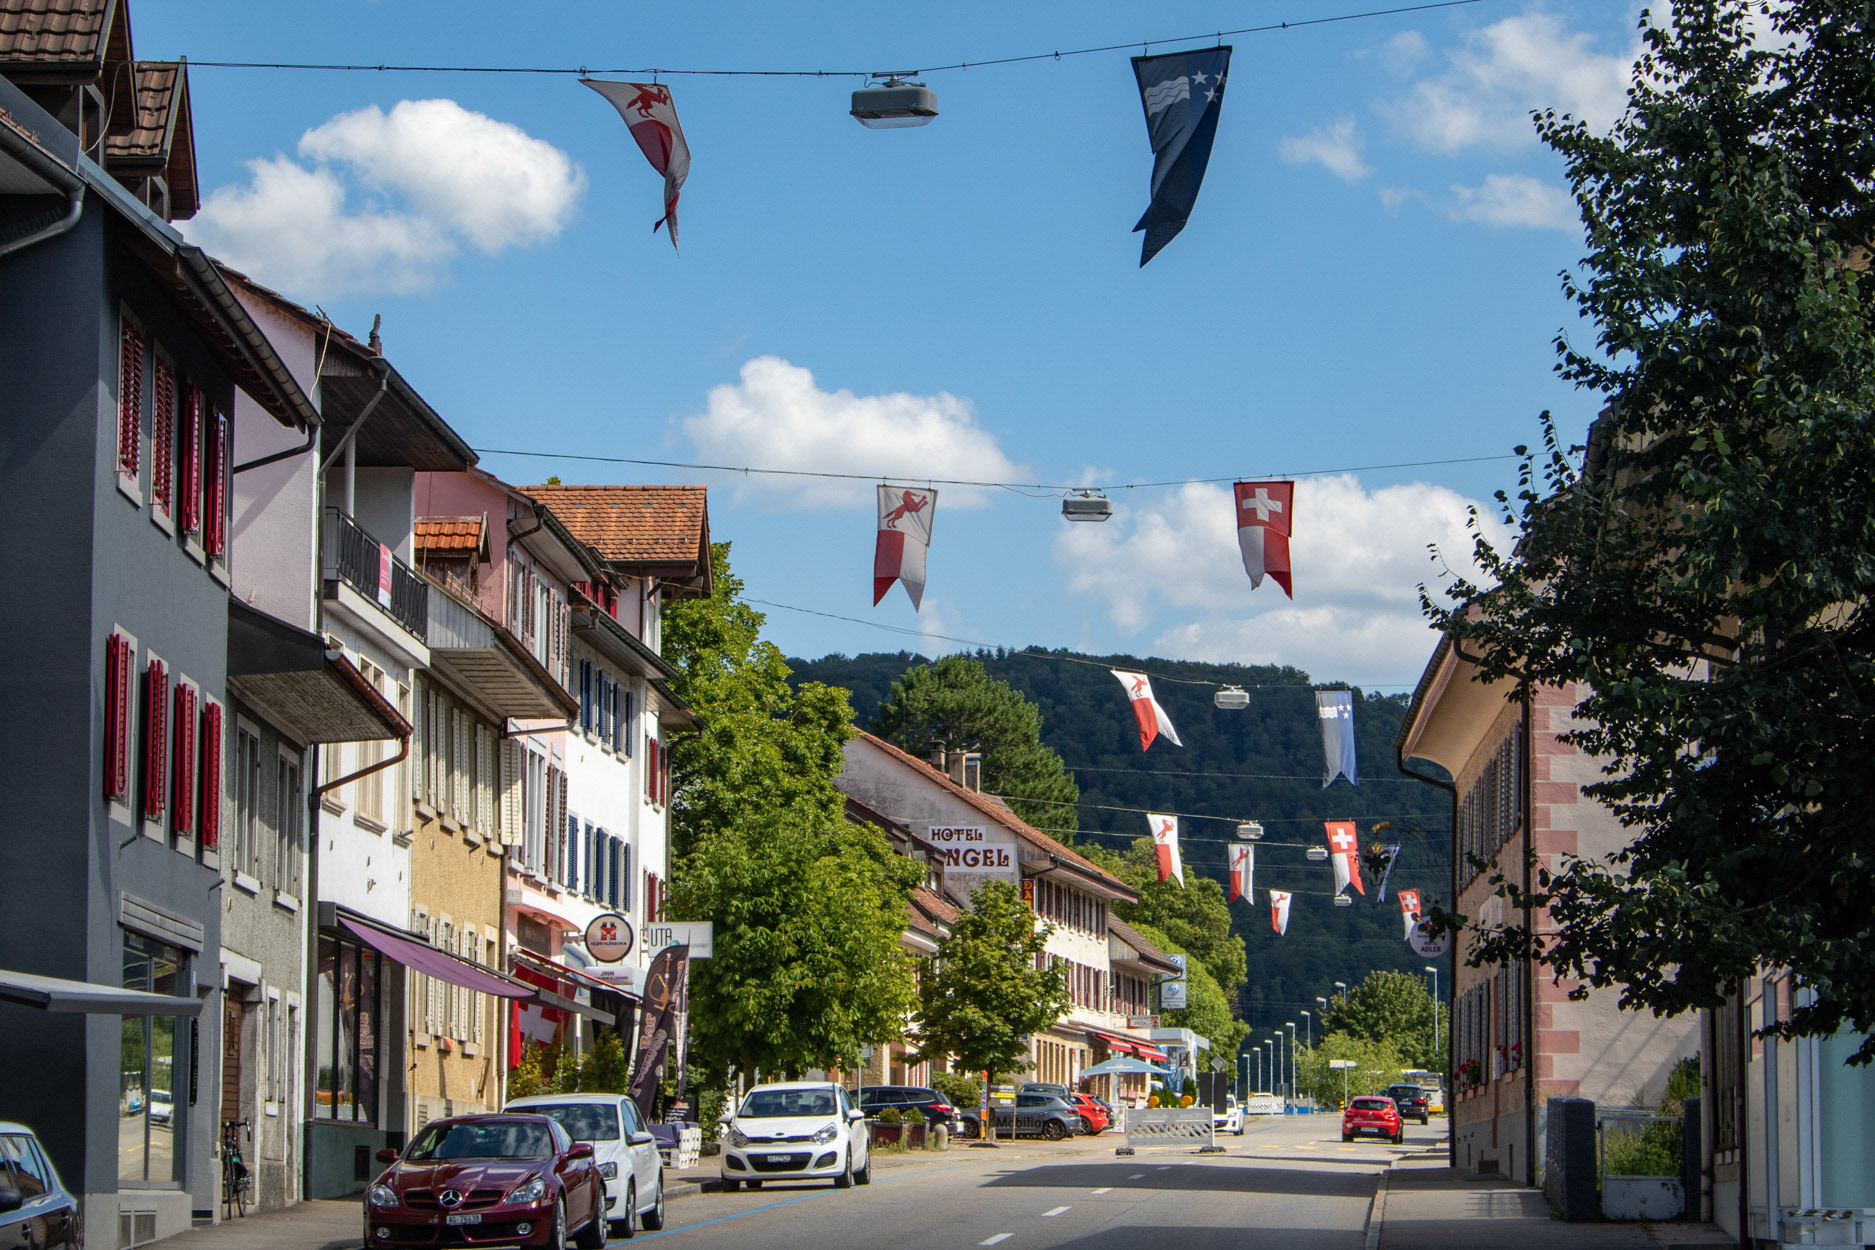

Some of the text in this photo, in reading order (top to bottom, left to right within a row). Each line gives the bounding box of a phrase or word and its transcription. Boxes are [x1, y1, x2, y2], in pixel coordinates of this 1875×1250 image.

[931, 828, 983, 841] HOTEL
[945, 848, 1010, 868] NGEL
[639, 1012, 657, 1050] Bar
